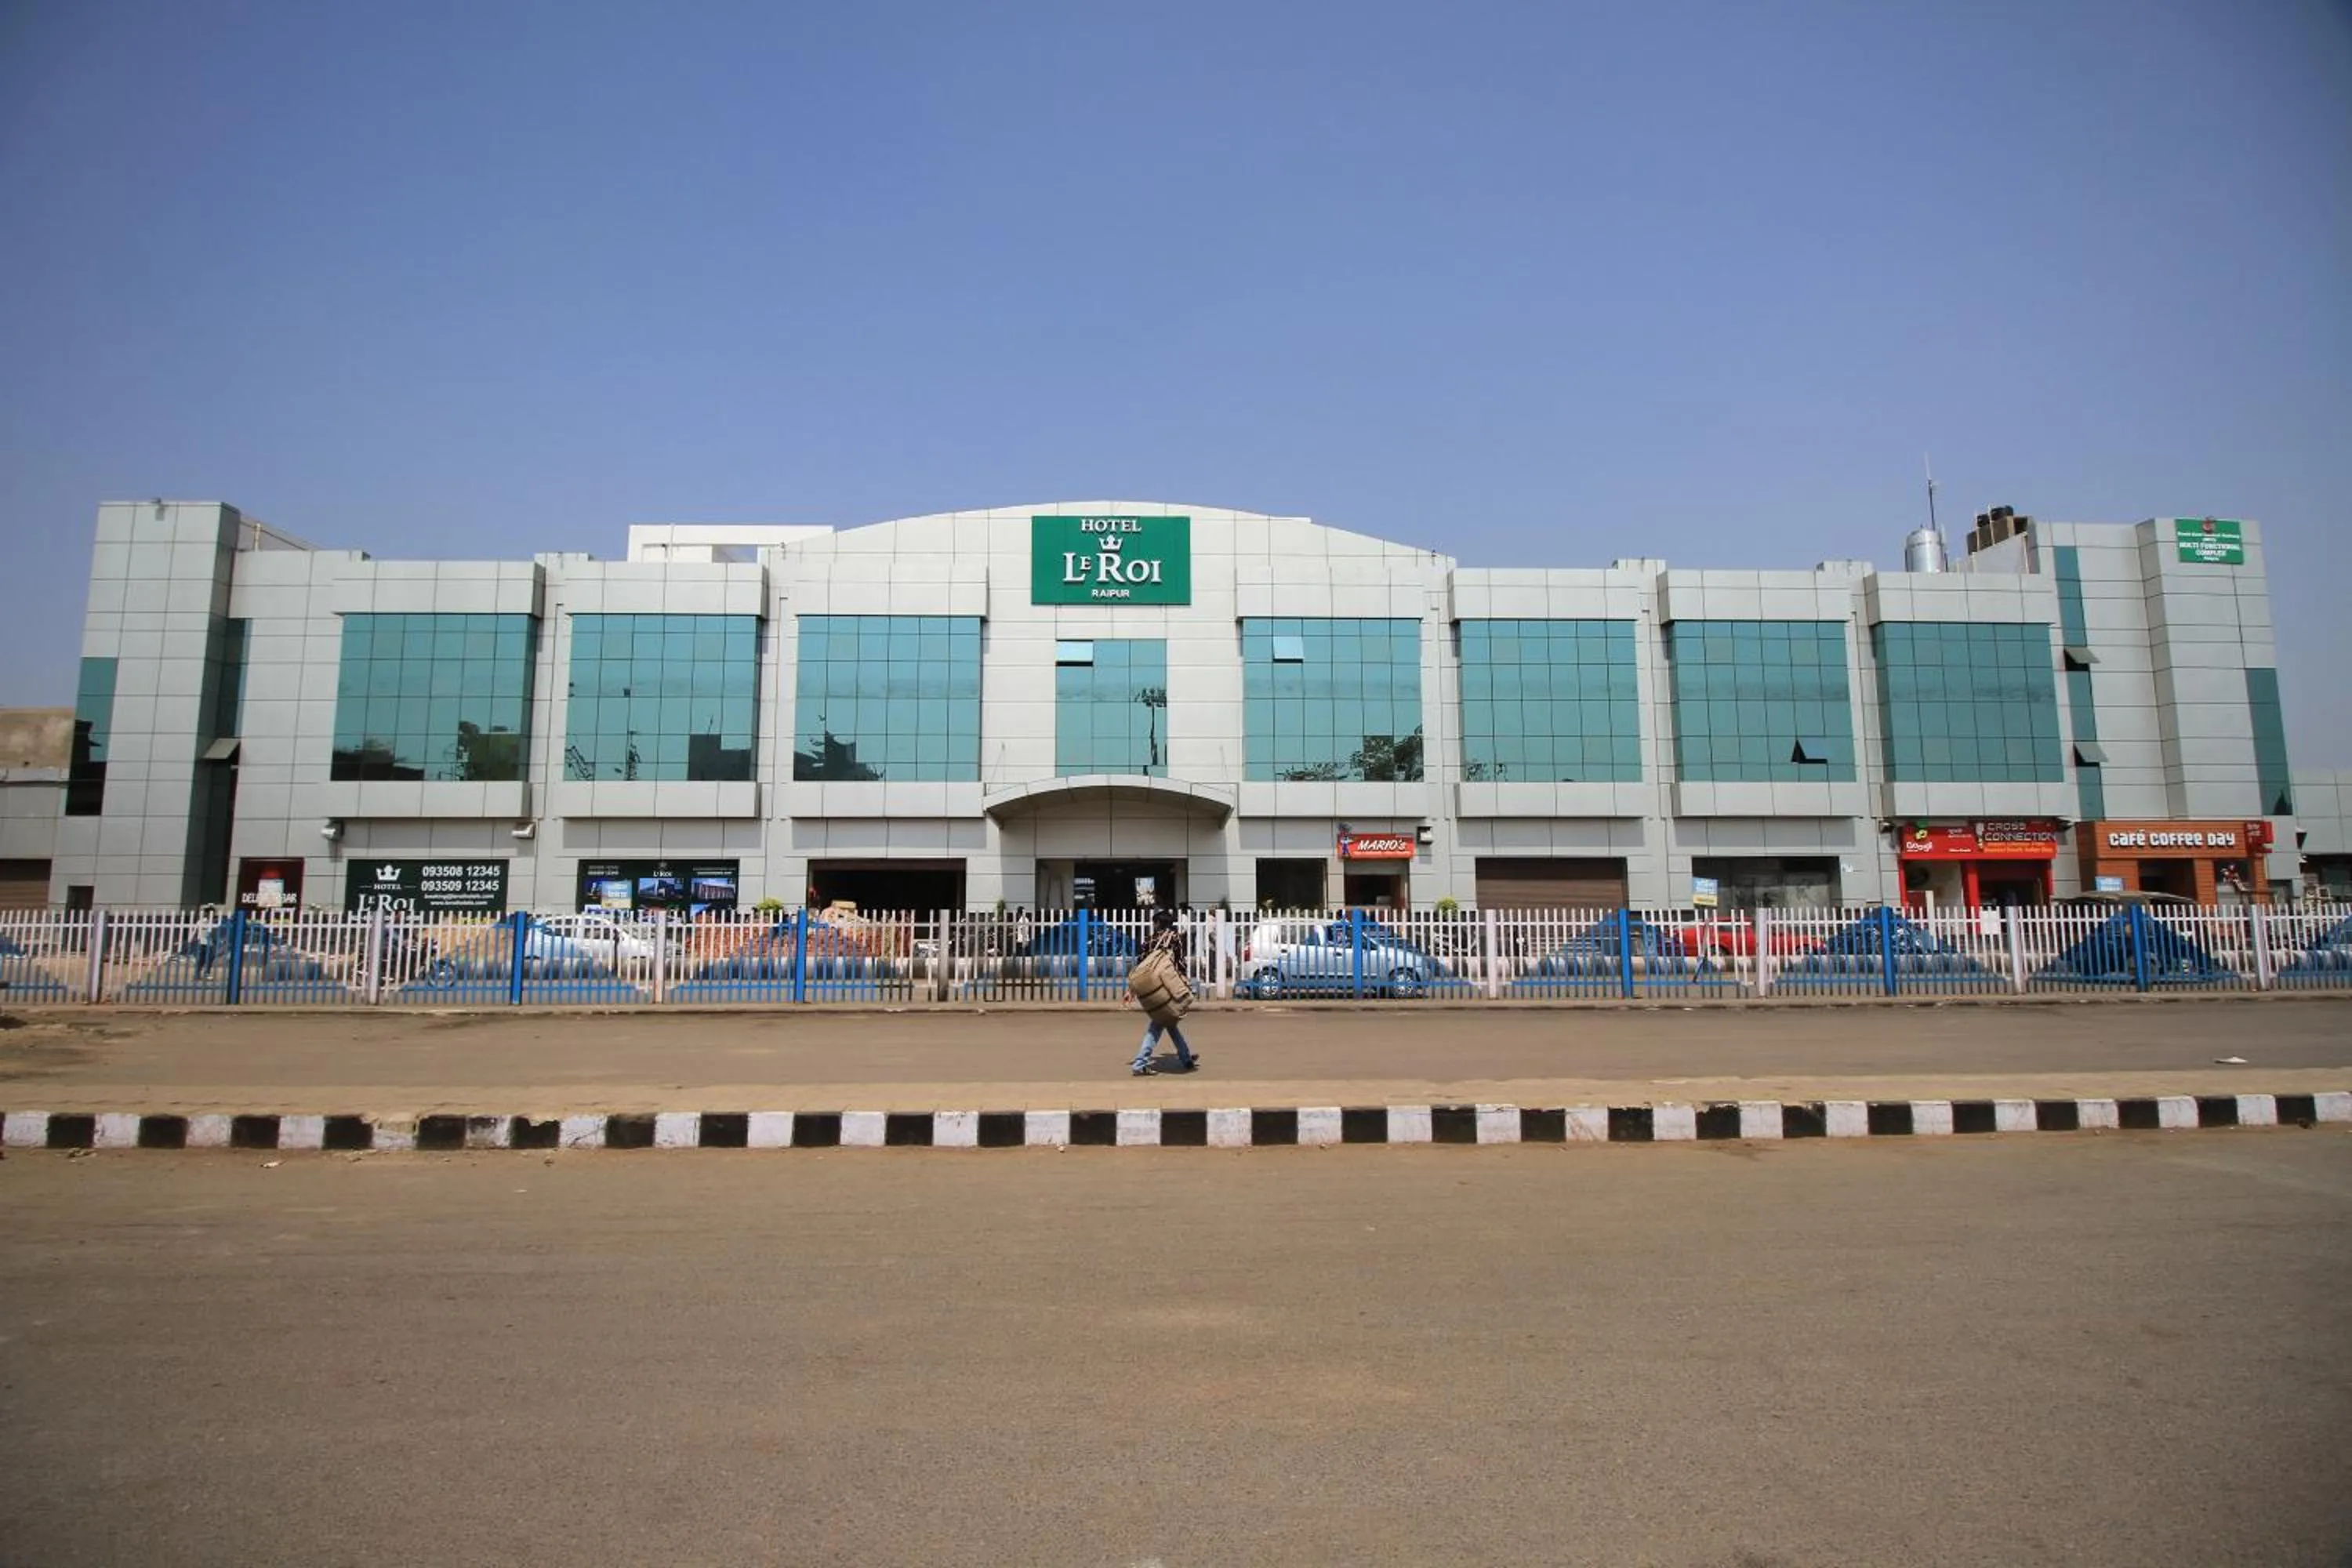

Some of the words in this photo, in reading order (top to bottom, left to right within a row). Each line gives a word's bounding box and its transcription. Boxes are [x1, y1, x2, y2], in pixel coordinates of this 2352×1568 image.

[1081, 519, 1142, 532] HOTEL
[1091, 589, 1130, 597] RAIPUR
[1984, 832, 2056, 841] CONNECTION
[423, 866, 463, 877] 093508
[466, 866, 501, 877] 12345
[421, 880, 463, 891] 093509
[465, 880, 499, 891] 12345
